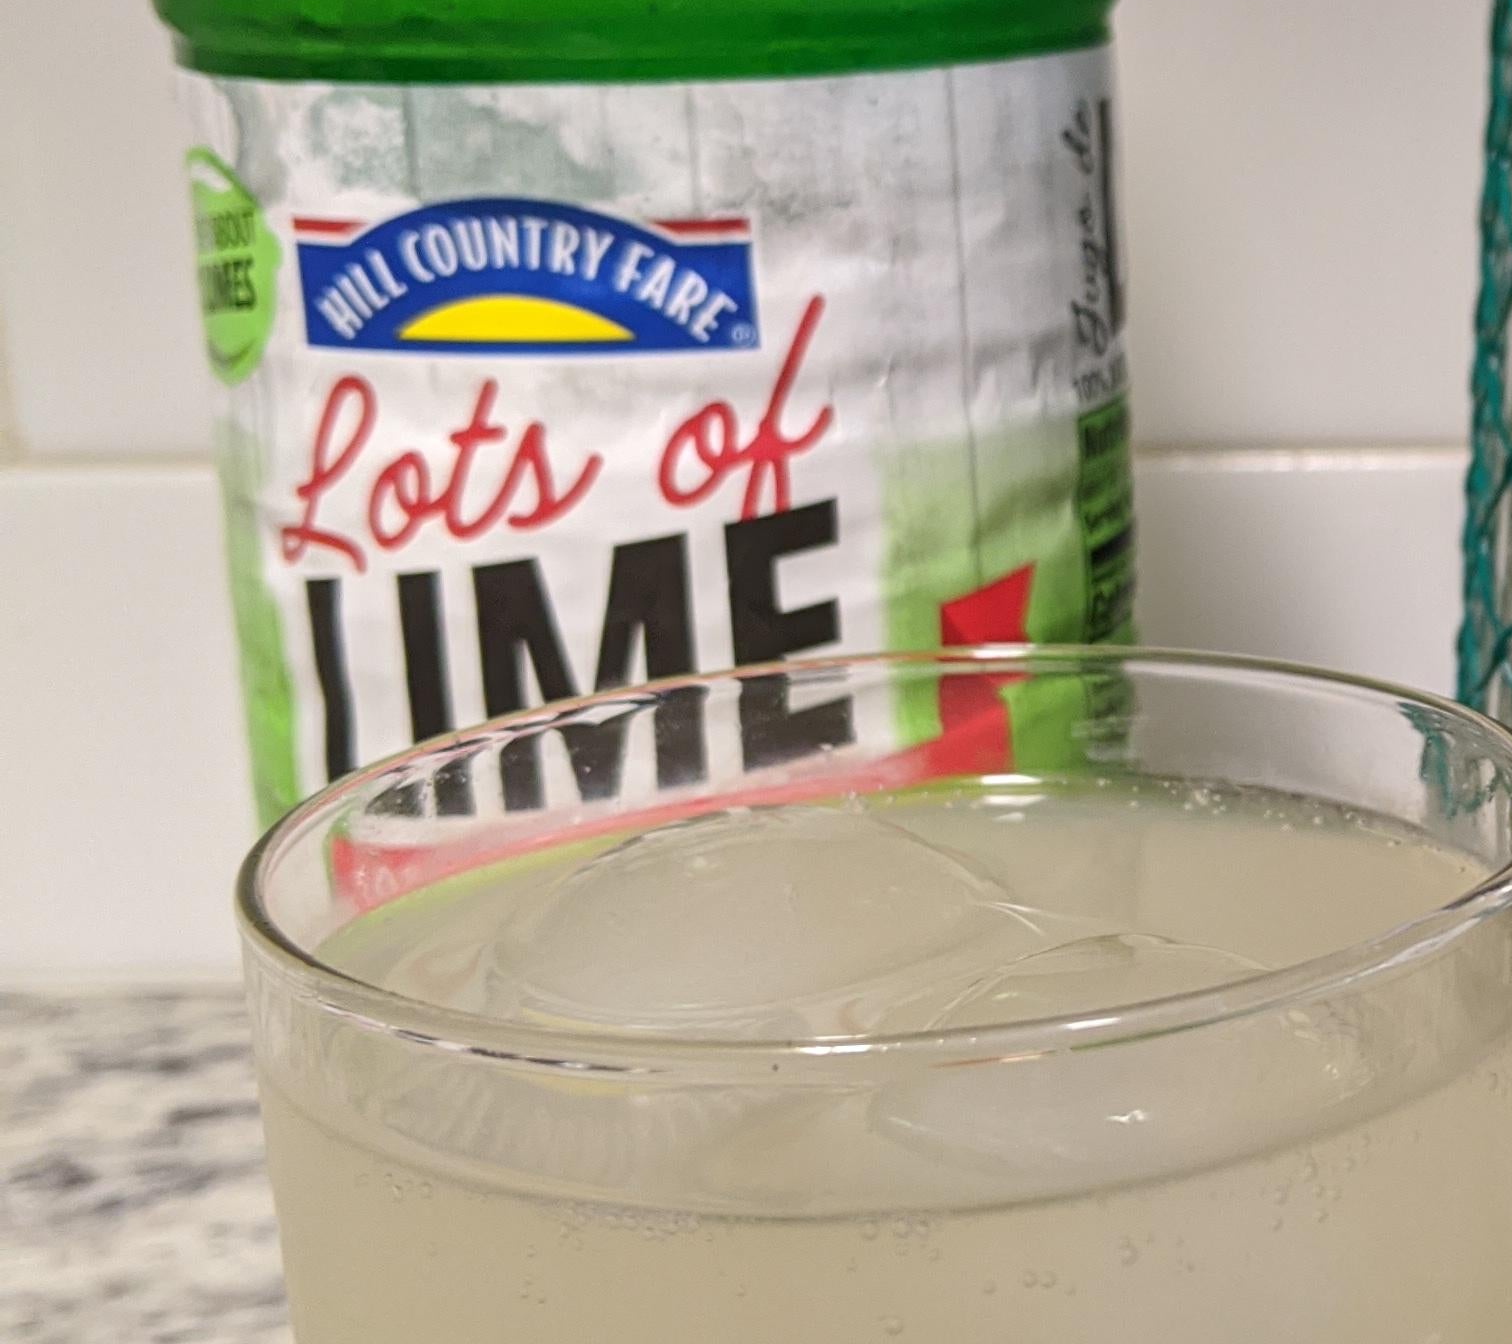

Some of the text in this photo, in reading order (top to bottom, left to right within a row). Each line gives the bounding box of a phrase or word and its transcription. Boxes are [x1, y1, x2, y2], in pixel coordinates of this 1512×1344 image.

[317, 214, 739, 343] HILL COUNTRY FARE
[281, 294, 834, 574] Lots of
